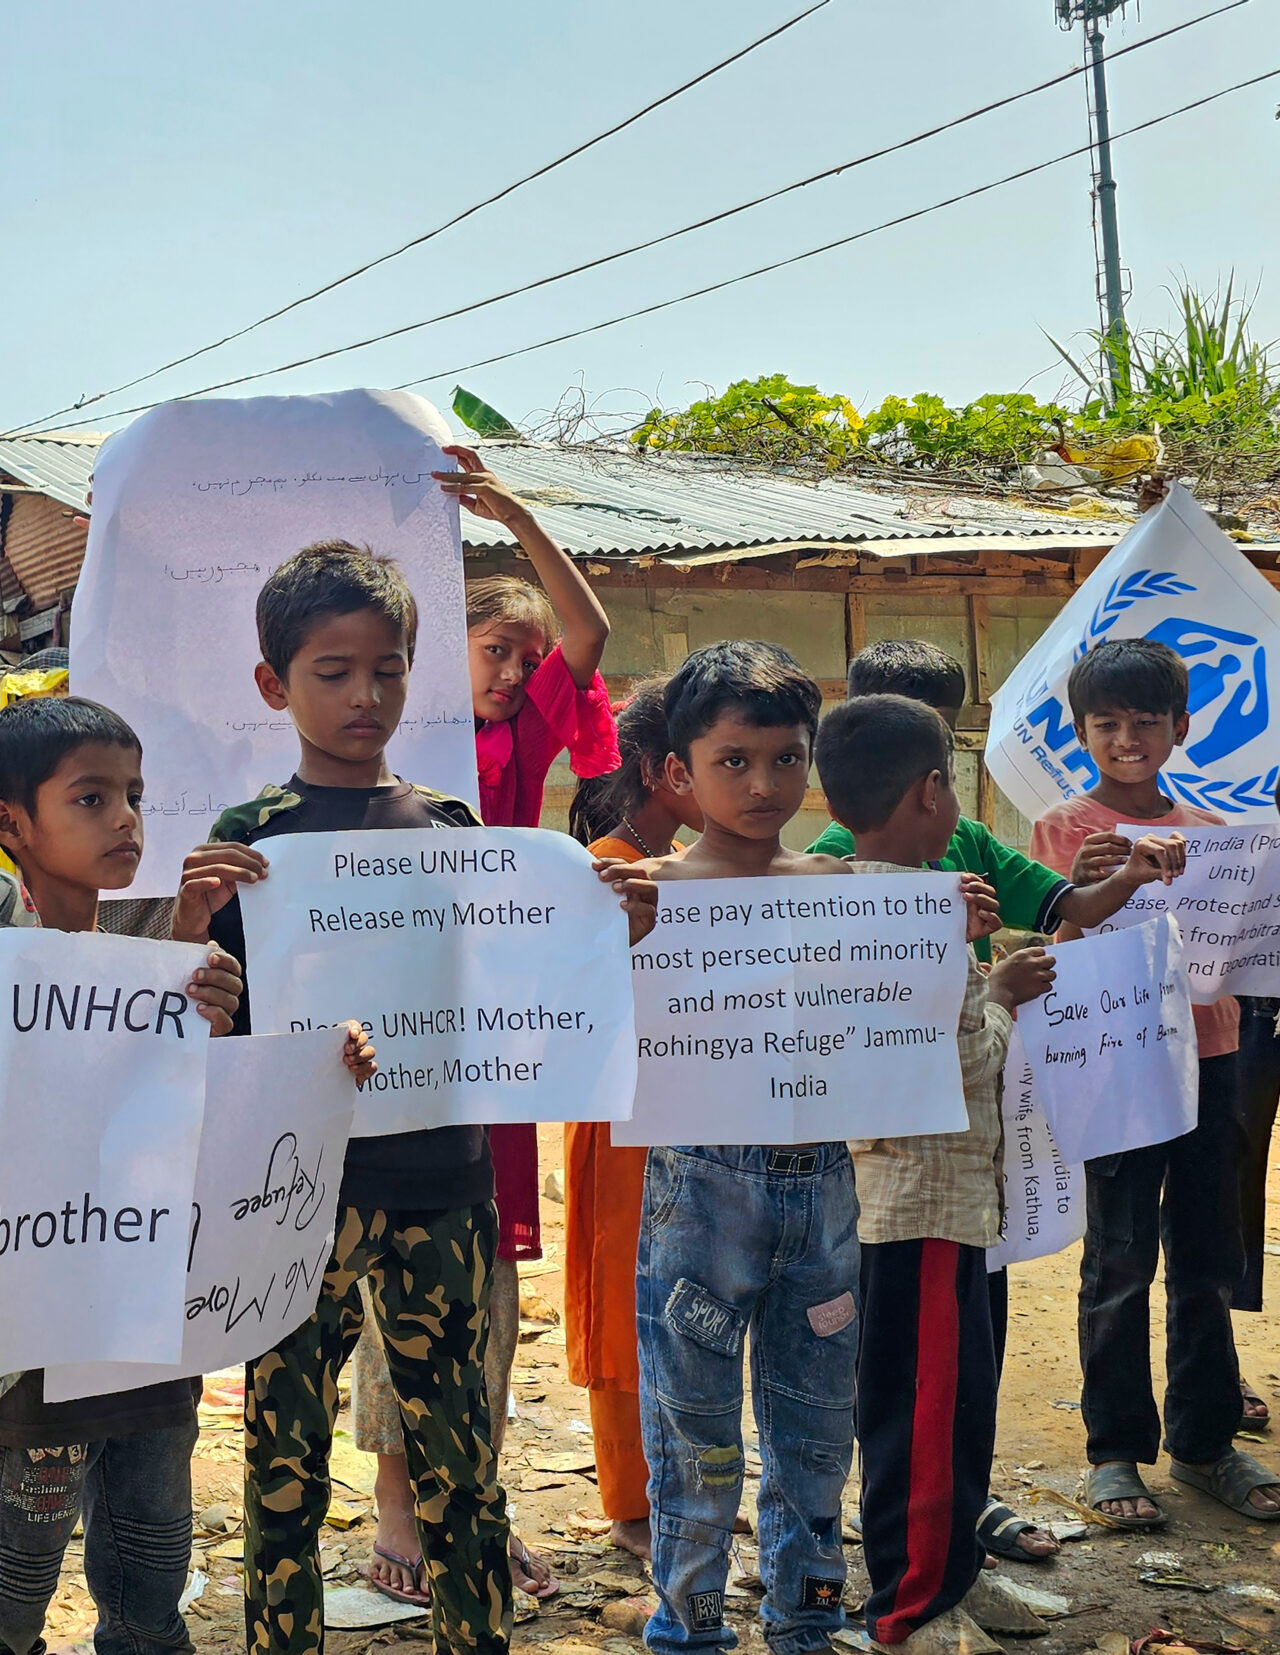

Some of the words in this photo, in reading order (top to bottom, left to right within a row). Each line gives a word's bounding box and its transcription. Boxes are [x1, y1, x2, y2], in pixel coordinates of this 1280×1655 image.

[1204, 837, 1244, 853] India
[335, 852, 412, 878] Please
[421, 849, 517, 874] UNHCR
[1209, 865, 1255, 886] Unit)
[309, 906, 404, 932] Release
[412, 908, 445, 932] my
[452, 900, 555, 925] Mother
[655, 903, 700, 925] ase
[710, 904, 752, 927] pay
[762, 897, 875, 919] attention
[883, 896, 907, 915] to
[914, 892, 951, 914] the
[1122, 895, 1169, 912] ease,
[1176, 897, 1248, 915] Protect
[1191, 926, 1239, 946] from
[631, 948, 693, 970] most
[703, 939, 840, 972] persecuted
[851, 938, 947, 964] minority
[13, 982, 188, 1038] UNHCR
[668, 989, 713, 1014] and
[724, 989, 786, 1010] most
[794, 981, 912, 1007] vulnerable
[1043, 991, 1088, 1026] Save
[1101, 990, 1126, 1013] Our
[382, 1007, 465, 1038] UNHCR!
[477, 1005, 593, 1034] Mother,
[638, 1034, 753, 1060] Rohingya
[864, 1027, 945, 1048] Jammu-
[1046, 1045, 1086, 1068] burning
[1137, 1027, 1147, 1048] of
[444, 1056, 542, 1084] Mother
[771, 1074, 827, 1098] India
[1015, 1090, 1032, 1121] wife
[1017, 1126, 1033, 1169] from
[1024, 1176, 1042, 1240] Kathua,
[1057, 1196, 1071, 1214] to
[282, 1240, 327, 1319] No
[185, 1273, 276, 1333] More
